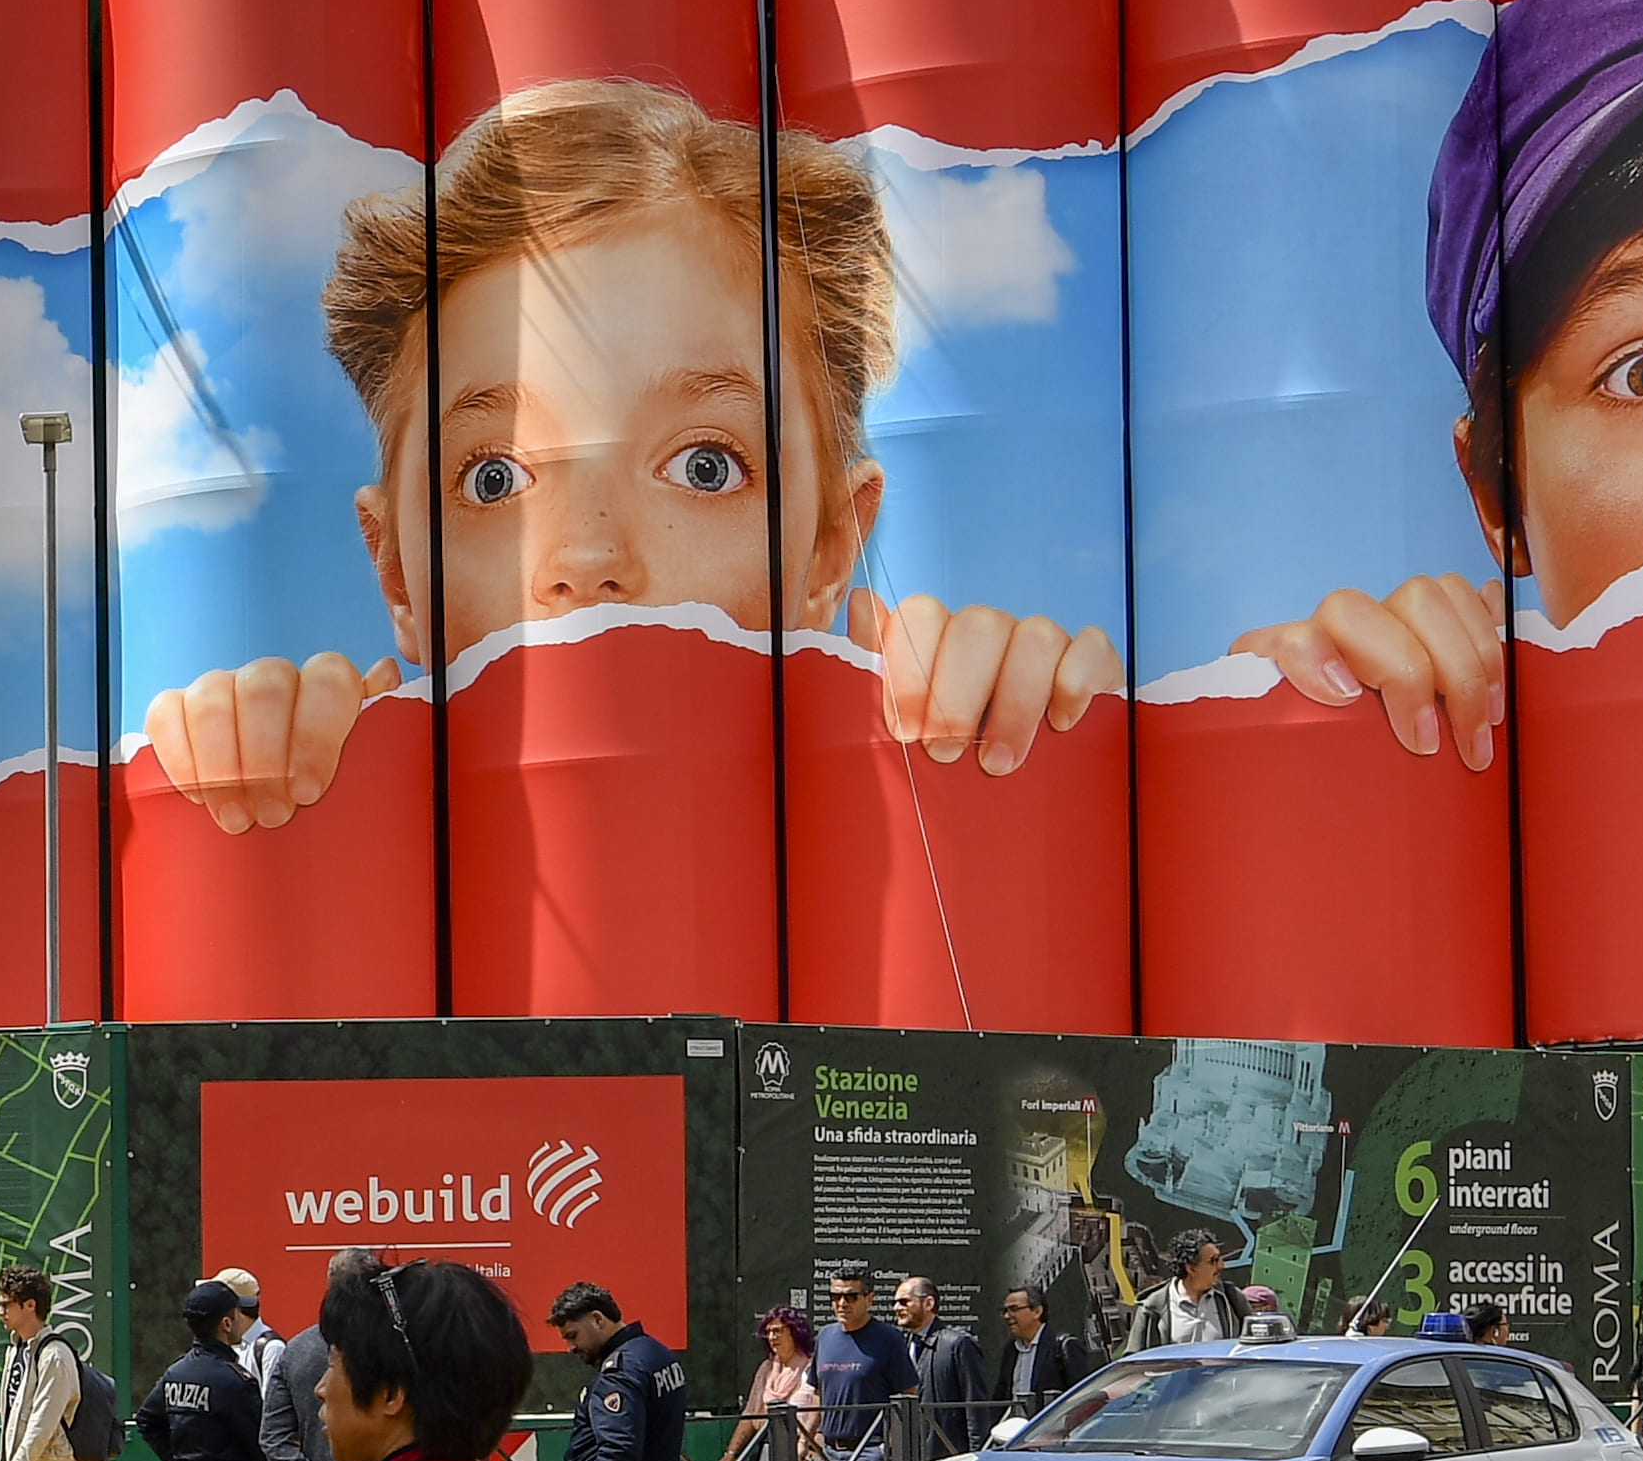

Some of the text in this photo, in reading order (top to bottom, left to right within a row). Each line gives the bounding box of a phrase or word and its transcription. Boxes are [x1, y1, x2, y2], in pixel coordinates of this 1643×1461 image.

[815, 1065, 918, 1093] Stazione
[814, 1093, 909, 1120] Venezia
[1021, 1099, 1040, 1112] Fori
[1043, 1099, 1081, 1113] Imperiali
[814, 1125, 978, 1146] Una sfida straordinaria
[1293, 1121, 1335, 1135] Vittoriano
[1448, 1141, 1511, 1177] piani
[1394, 1140, 1440, 1217] 6
[285, 1174, 511, 1226] webuild
[1448, 1177, 1550, 1211] interrati
[1449, 1223, 1539, 1239] underground floors
[475, 1262, 511, 1278] Italia
[814, 1258, 869, 1268] Venezia Station
[814, 1270, 823, 1279] An
[874, 1270, 910, 1280] Challenge
[1448, 1253, 1564, 1284] accessi in
[1397, 1250, 1436, 1326] 3
[1448, 1284, 1573, 1319] superficie
[1593, 1220, 1622, 1383] ROMA
[164, 1381, 210, 1412] POLIZIA
